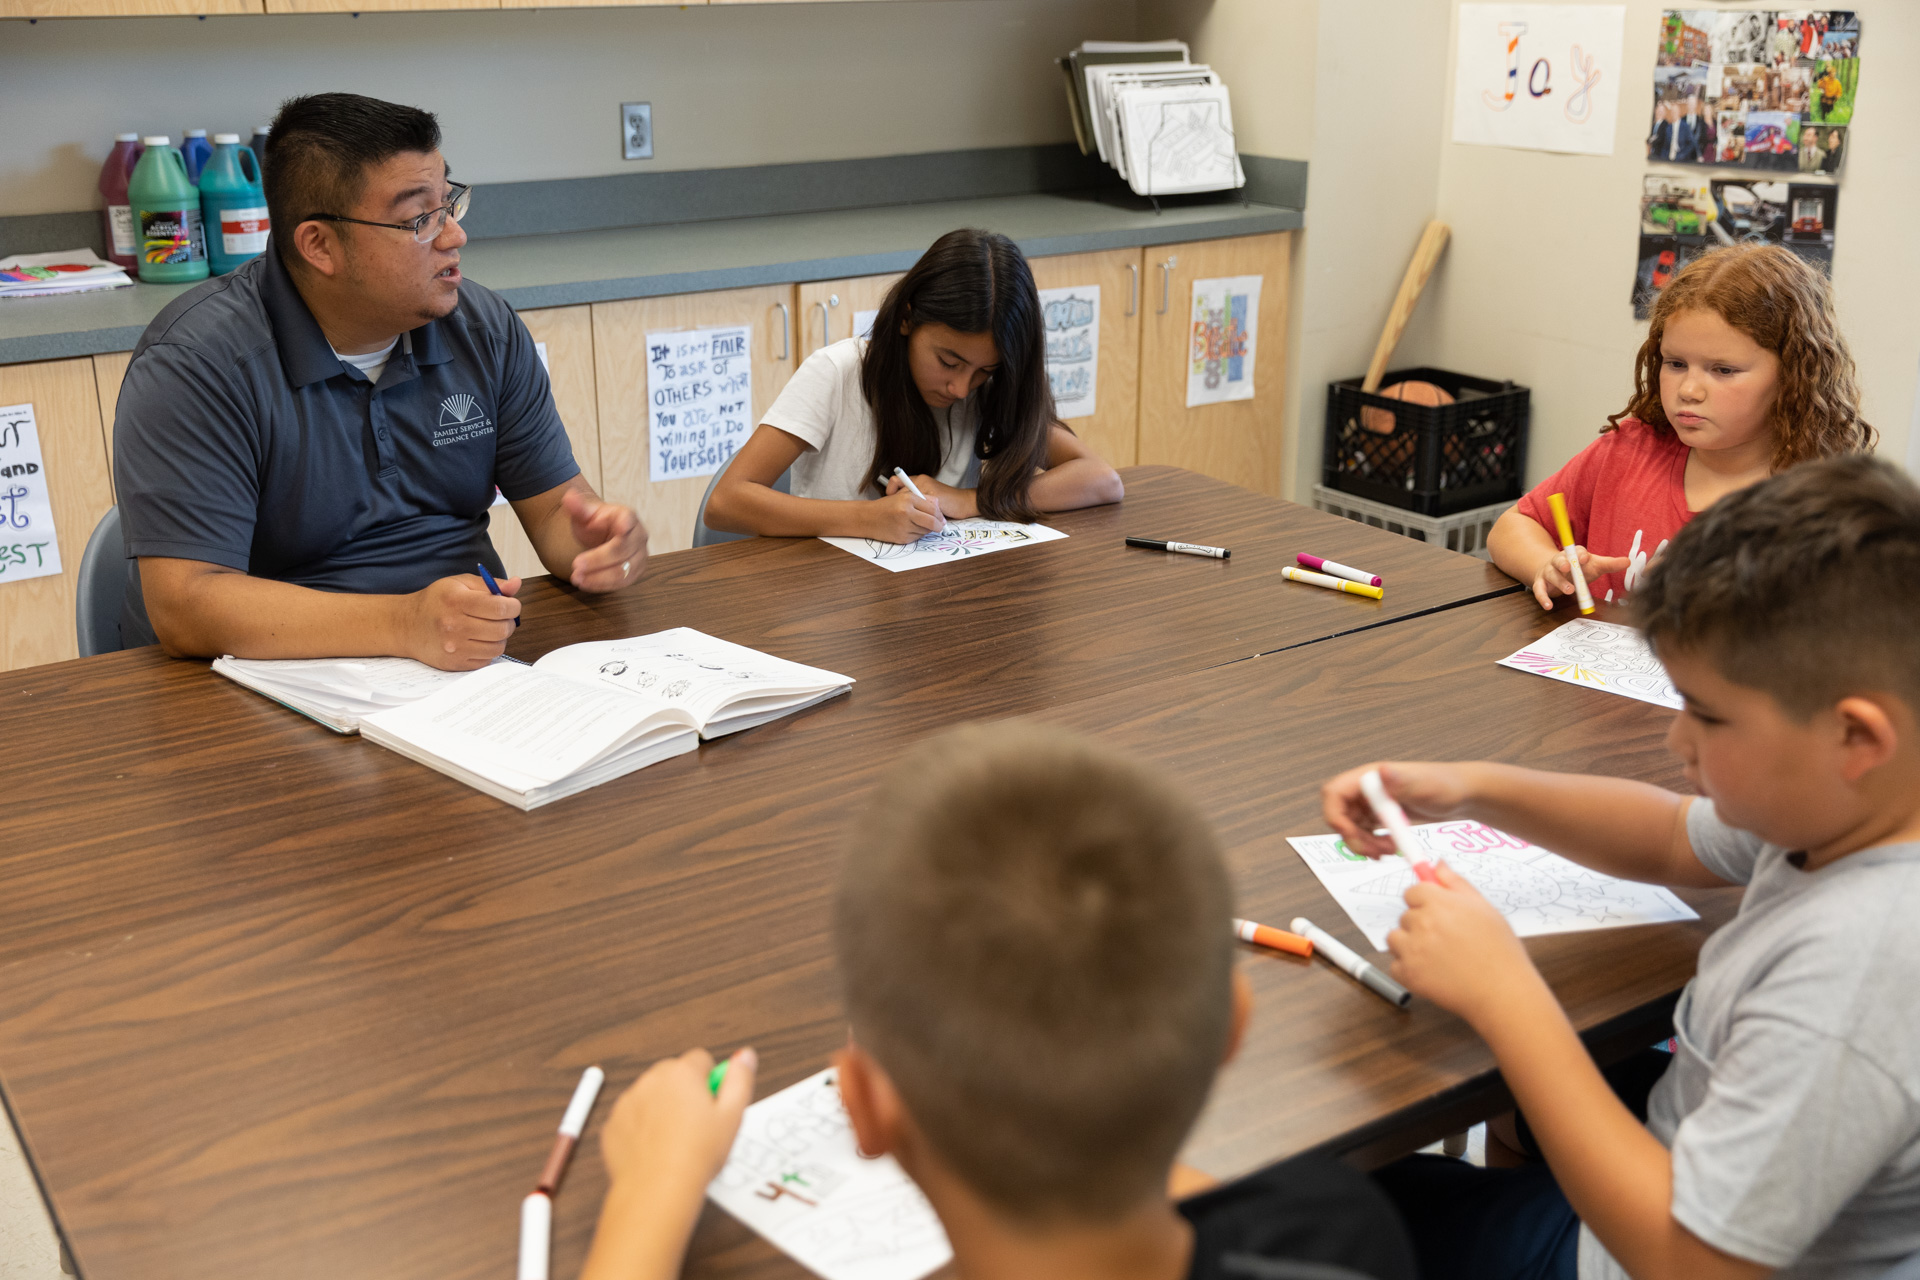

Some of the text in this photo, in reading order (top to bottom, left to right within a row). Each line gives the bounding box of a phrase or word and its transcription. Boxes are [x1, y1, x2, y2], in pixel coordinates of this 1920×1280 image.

[1481, 21, 1602, 125] Jay
[711, 336, 745, 355] FAIR
[654, 381, 712, 406] OTHERS
[432, 427, 494, 446] GUIDANCE CENTER
[433, 428, 458, 438] FAMILY
[460, 421, 484, 433] SERVICE
